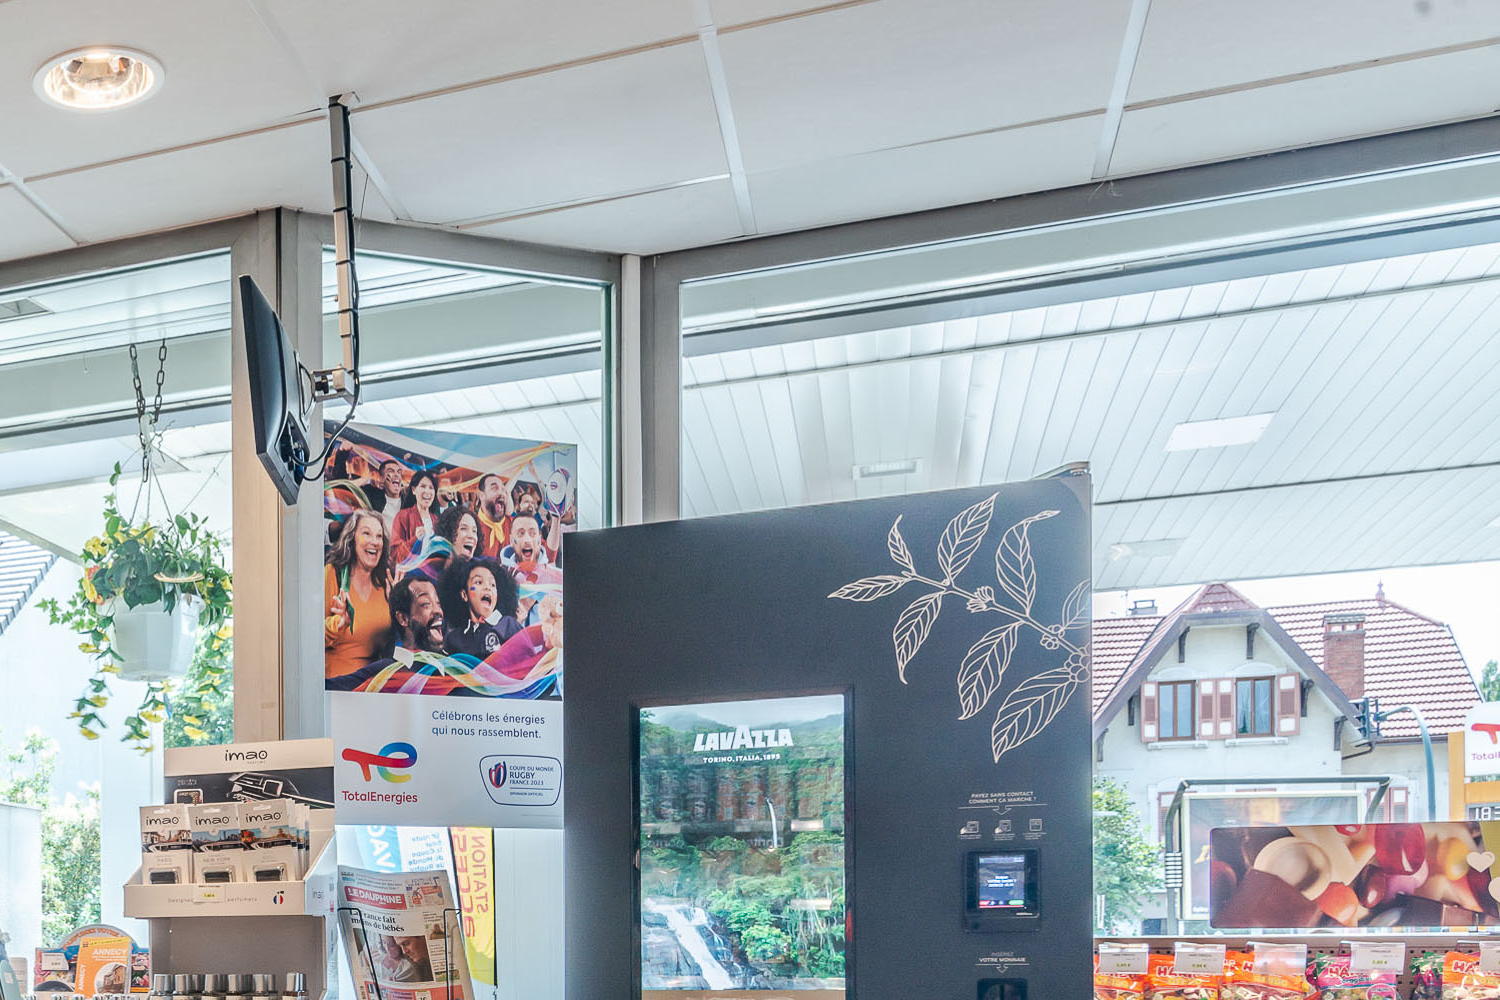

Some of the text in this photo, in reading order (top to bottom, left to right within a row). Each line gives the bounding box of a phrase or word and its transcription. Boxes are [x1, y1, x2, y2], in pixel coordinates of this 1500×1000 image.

[431, 710, 546, 726] Célébrons les énergies
[431, 725, 542, 739] qui nous rassemblent.
[692, 724, 795, 753] LAVAZZA
[224, 750, 269, 762] imao
[509, 771, 536, 780] RUGBY
[341, 790, 419, 805] TotalEnergies
[195, 816, 230, 826] imao
[381, 916, 397, 925] fait
[382, 922, 406, 933] bébés
[92, 948, 128, 956] ANNECY
